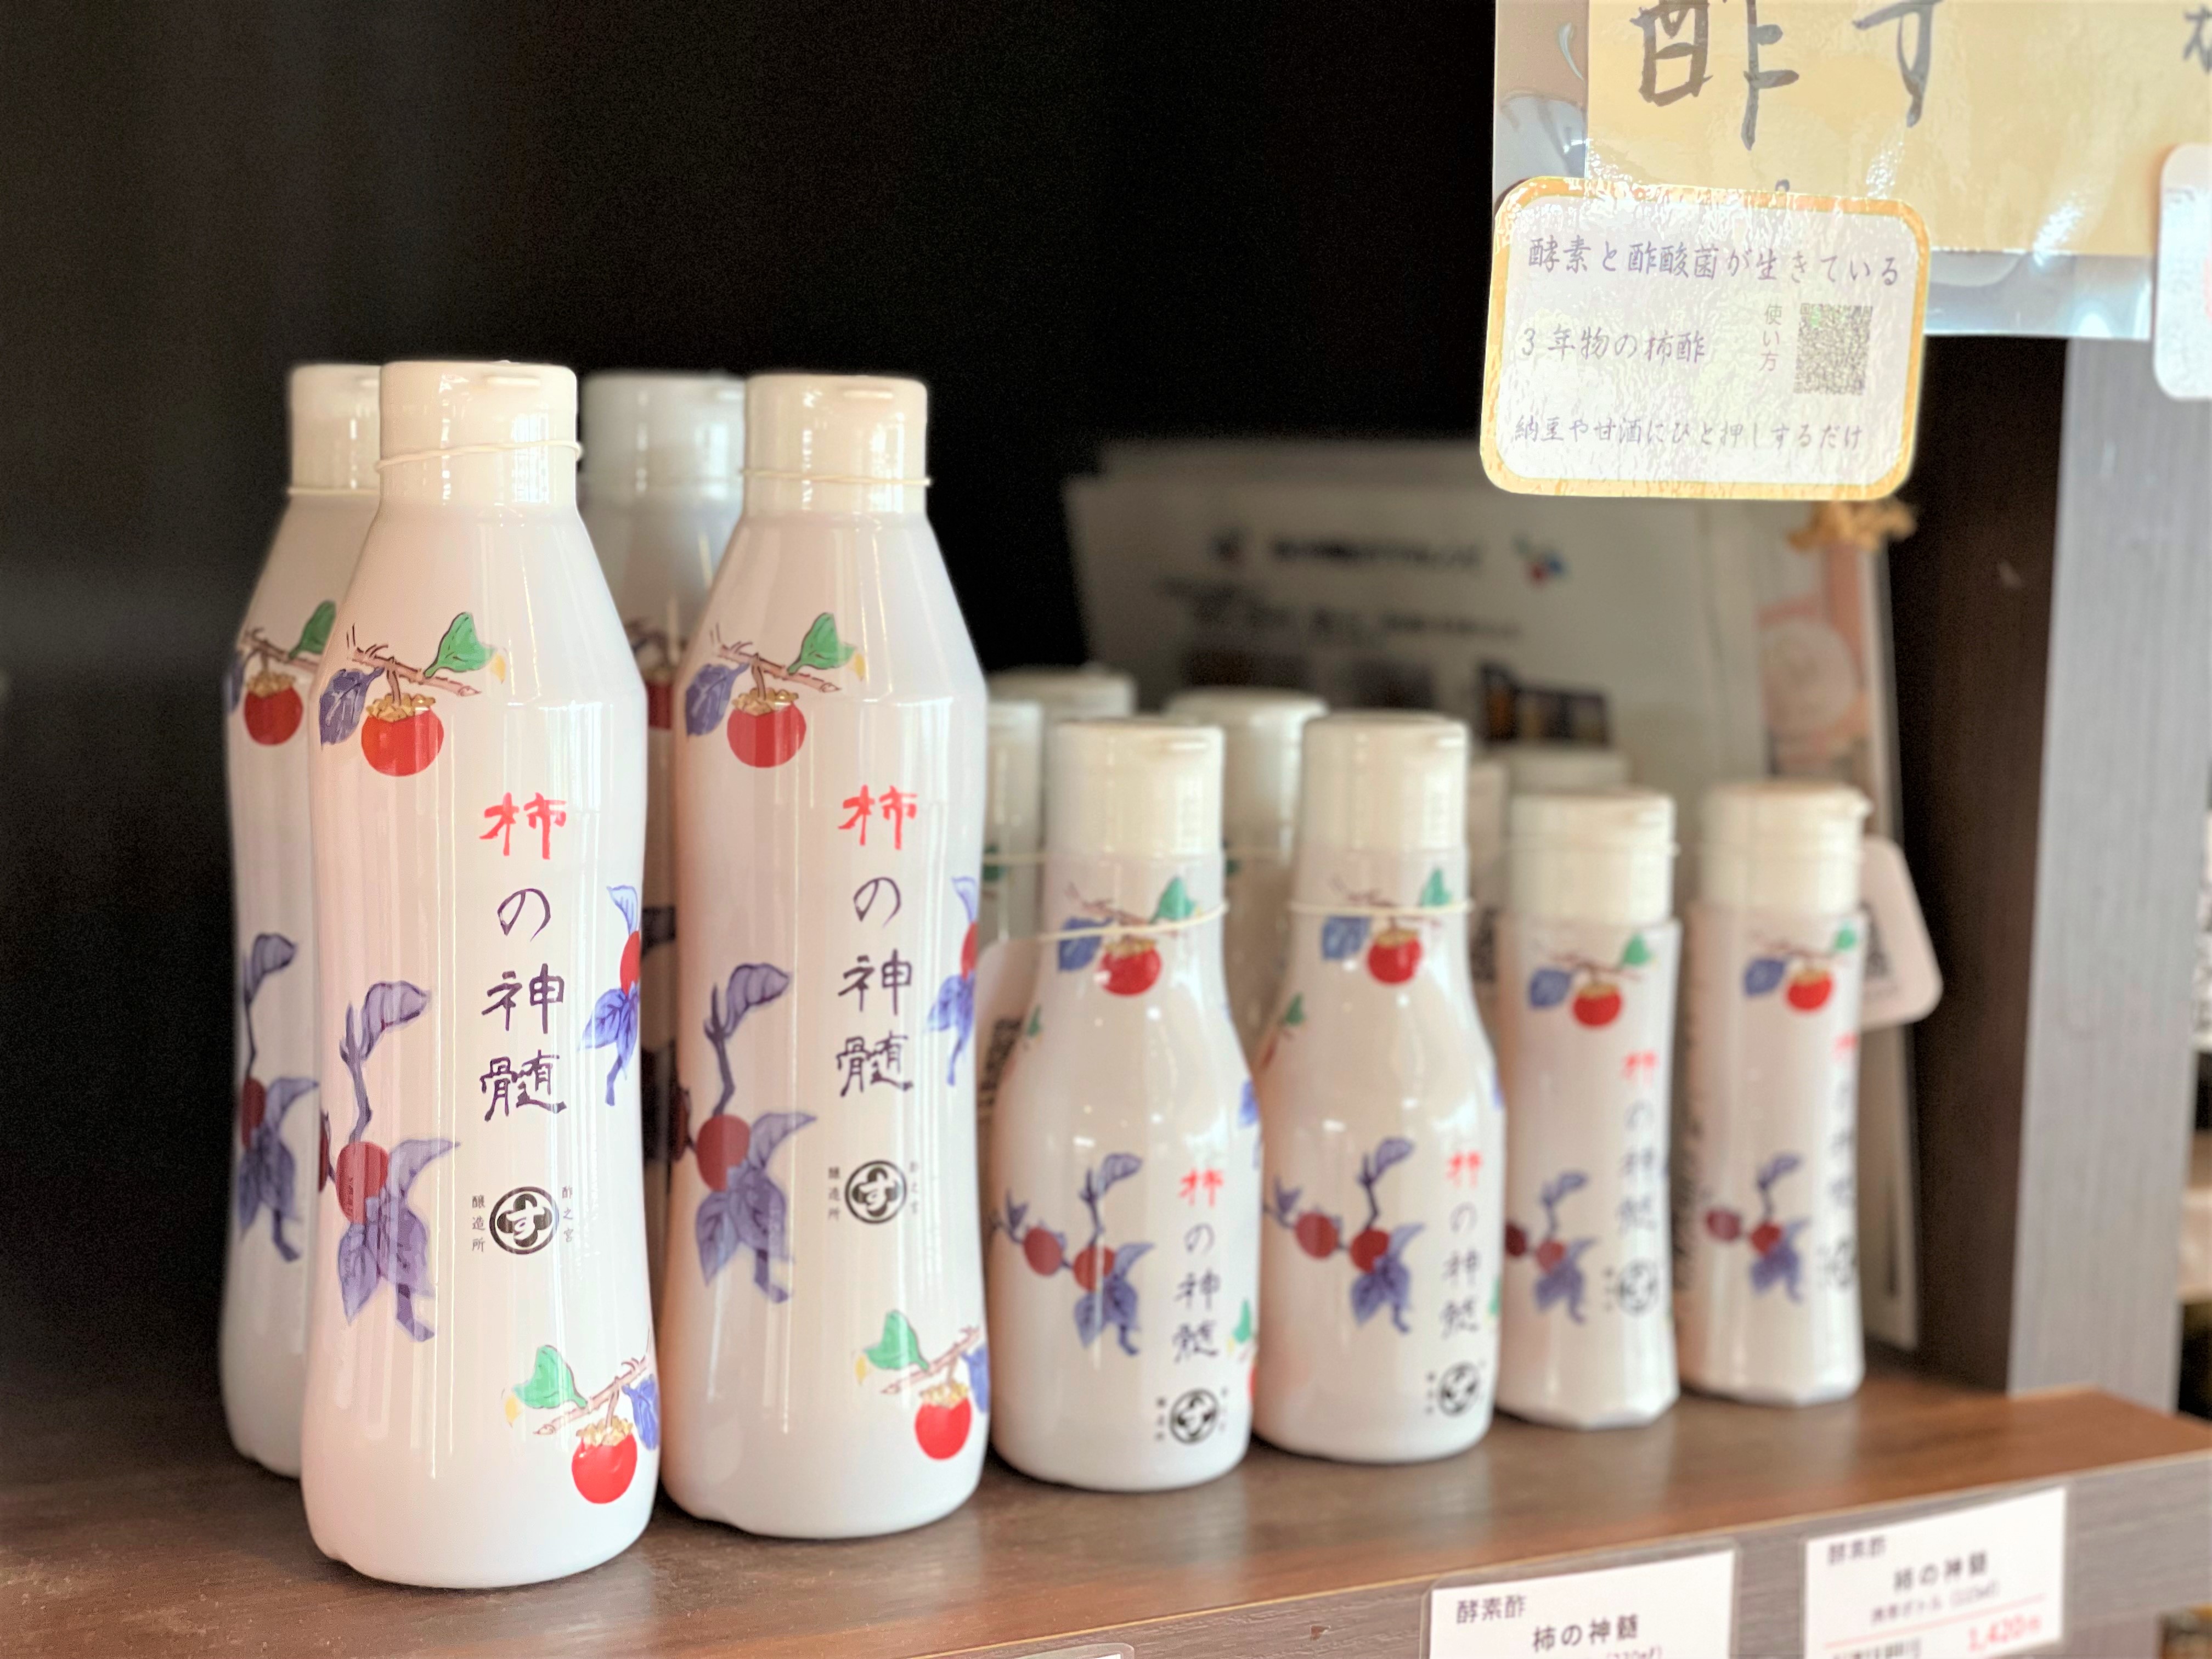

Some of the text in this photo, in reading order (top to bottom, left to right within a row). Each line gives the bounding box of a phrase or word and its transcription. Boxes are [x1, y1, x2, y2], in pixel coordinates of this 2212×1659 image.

[1528, 235, 1899, 286] 酵素と酢酸菌が生きている
[1759, 303, 1783, 372] 使い方
[480, 792, 567, 1121] 柿の神髄
[837, 785, 917, 1097] 柿の神髄
[1456, 1595, 1526, 1624] 酵素酢
